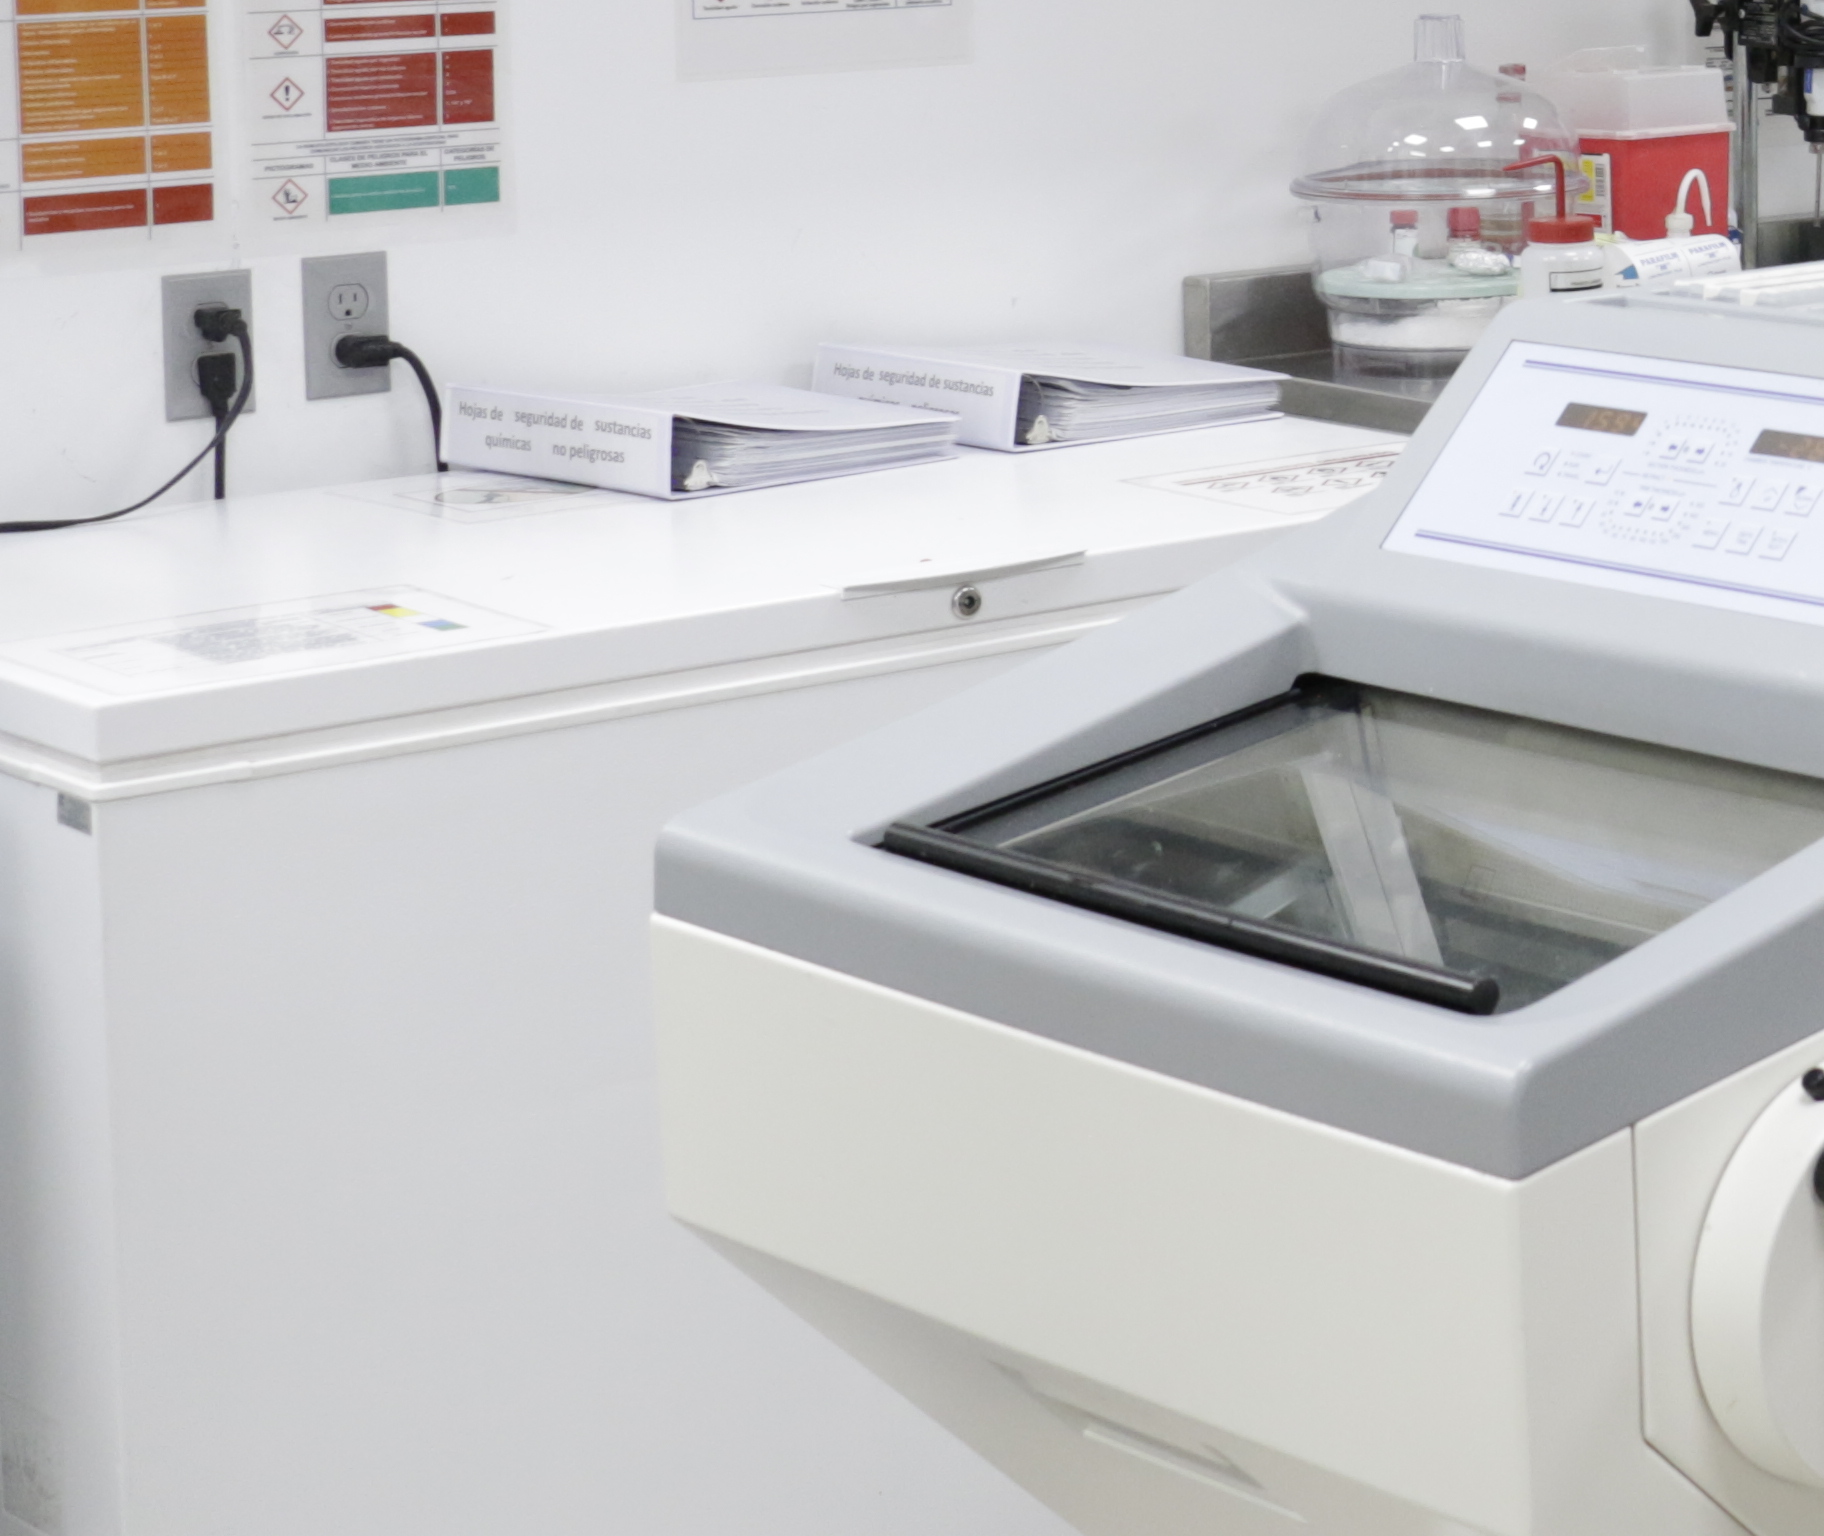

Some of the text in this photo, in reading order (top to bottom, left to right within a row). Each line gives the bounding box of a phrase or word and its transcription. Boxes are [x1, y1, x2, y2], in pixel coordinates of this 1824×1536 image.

[1688, 241, 1727, 256] PARAFILM
[833, 362, 994, 398] Hojas de seguridad de sustancias
[458, 400, 653, 441] Hojas de seguridad de sustancias
[485, 431, 625, 466] químicas no peligrosas
